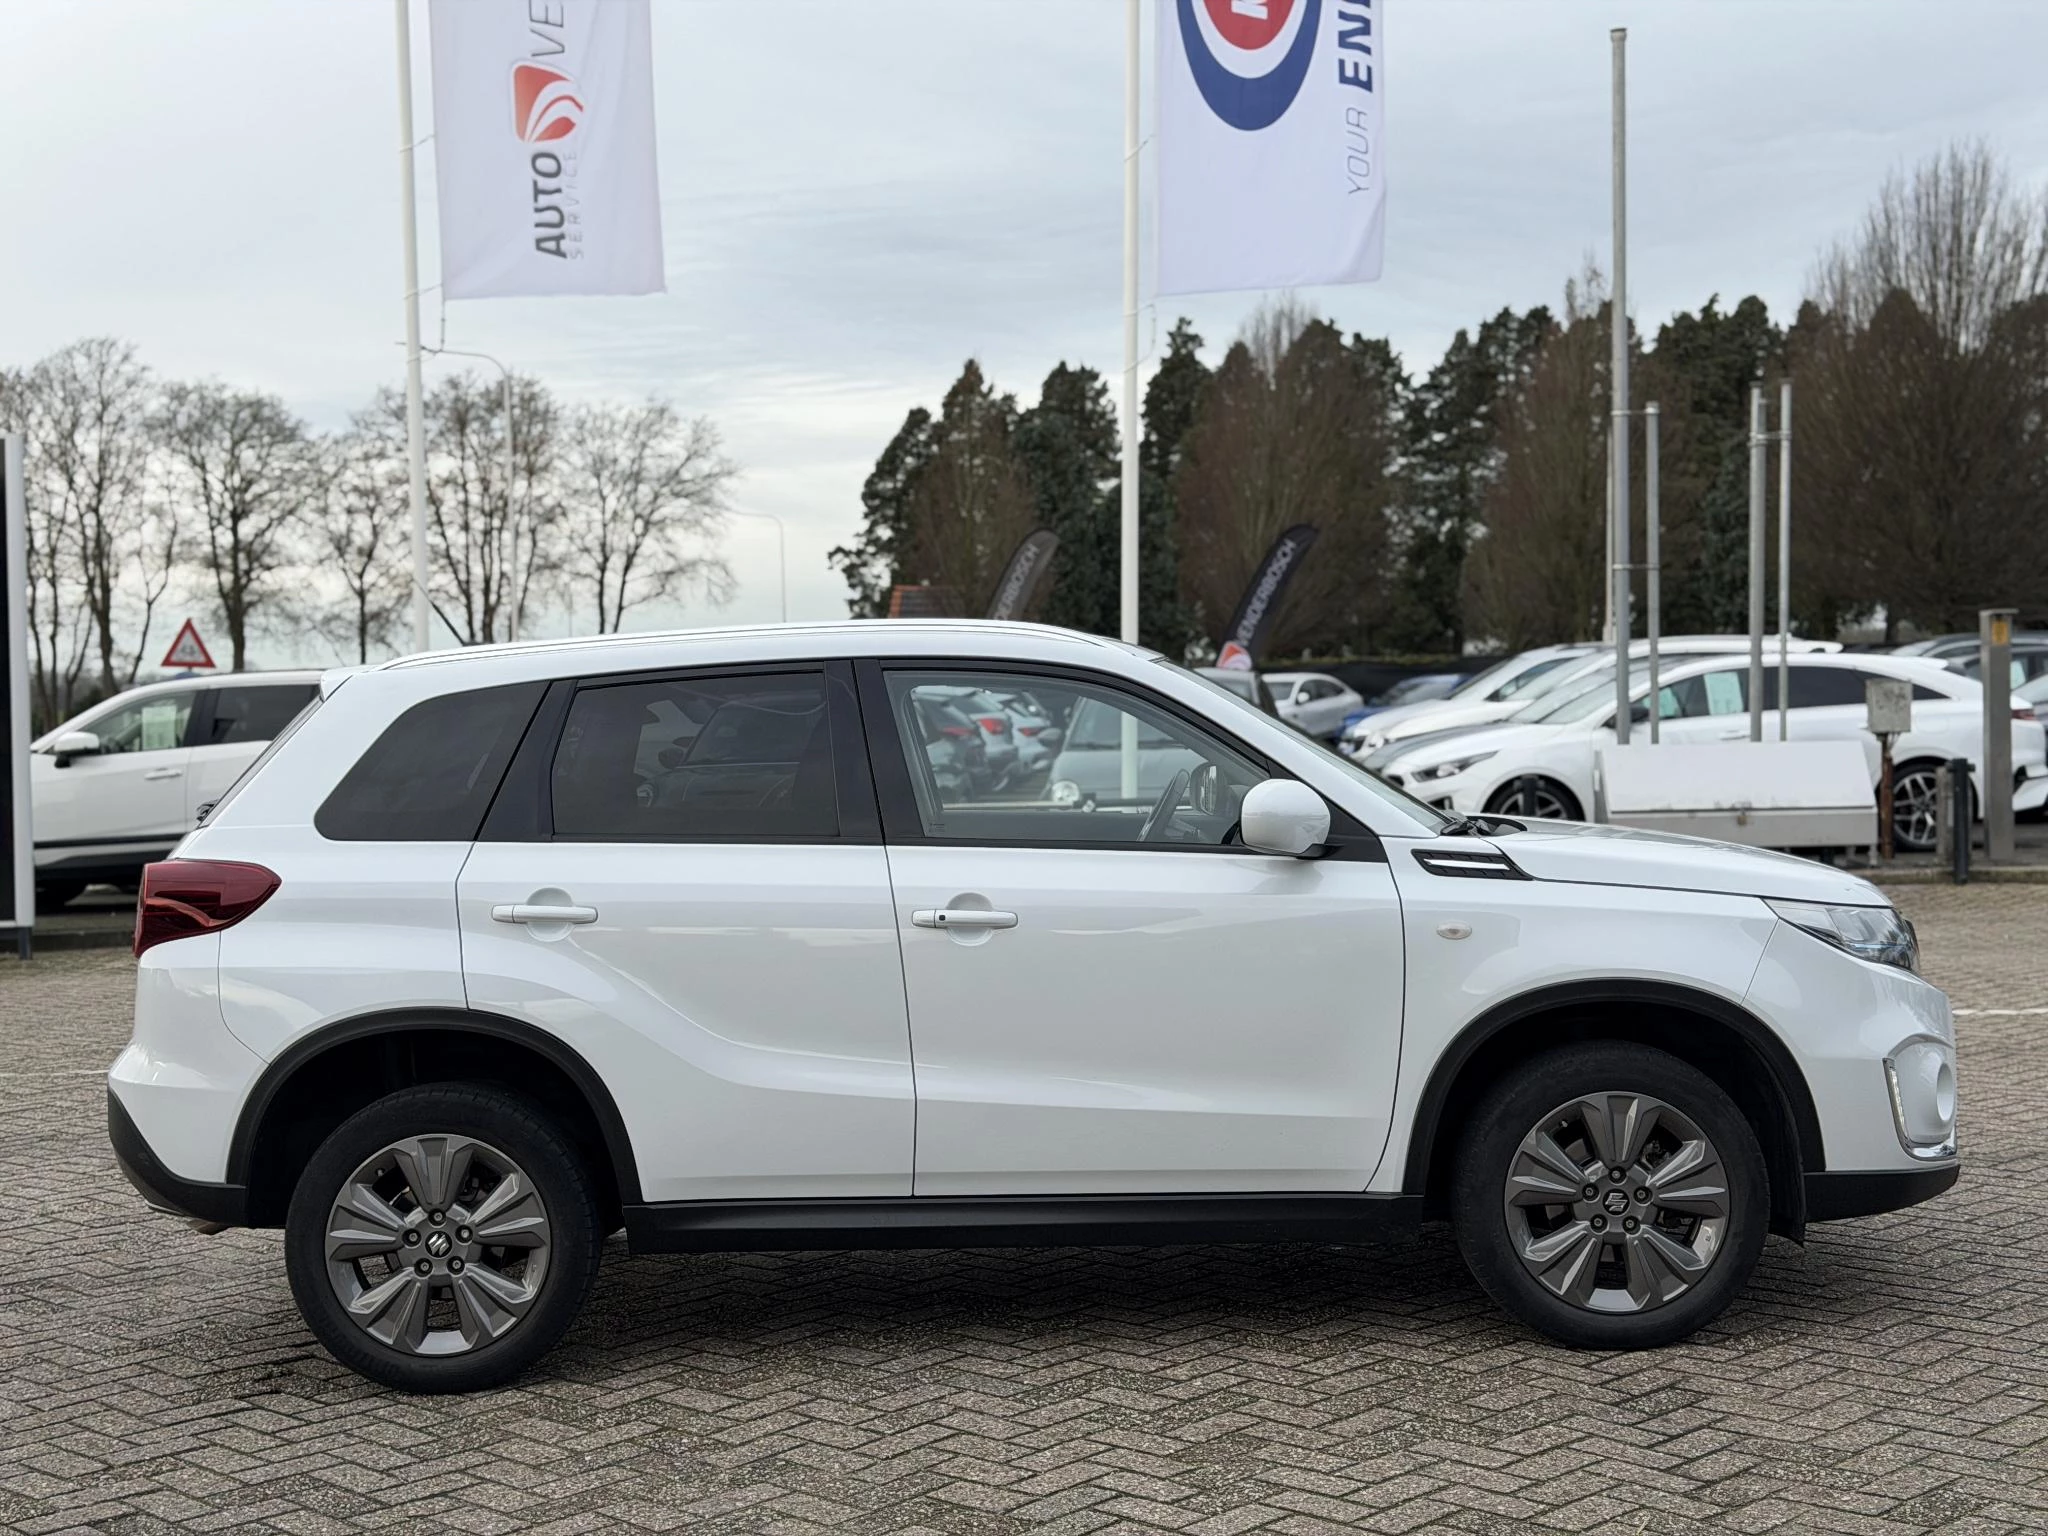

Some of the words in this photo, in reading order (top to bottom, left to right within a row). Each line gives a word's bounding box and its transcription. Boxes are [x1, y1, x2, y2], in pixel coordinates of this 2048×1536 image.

[1337, 0, 1374, 93] EN
[1345, 106, 1371, 195] YOUR
[530, 151, 568, 260] AUTO
[563, 151, 585, 261] SERVICE
